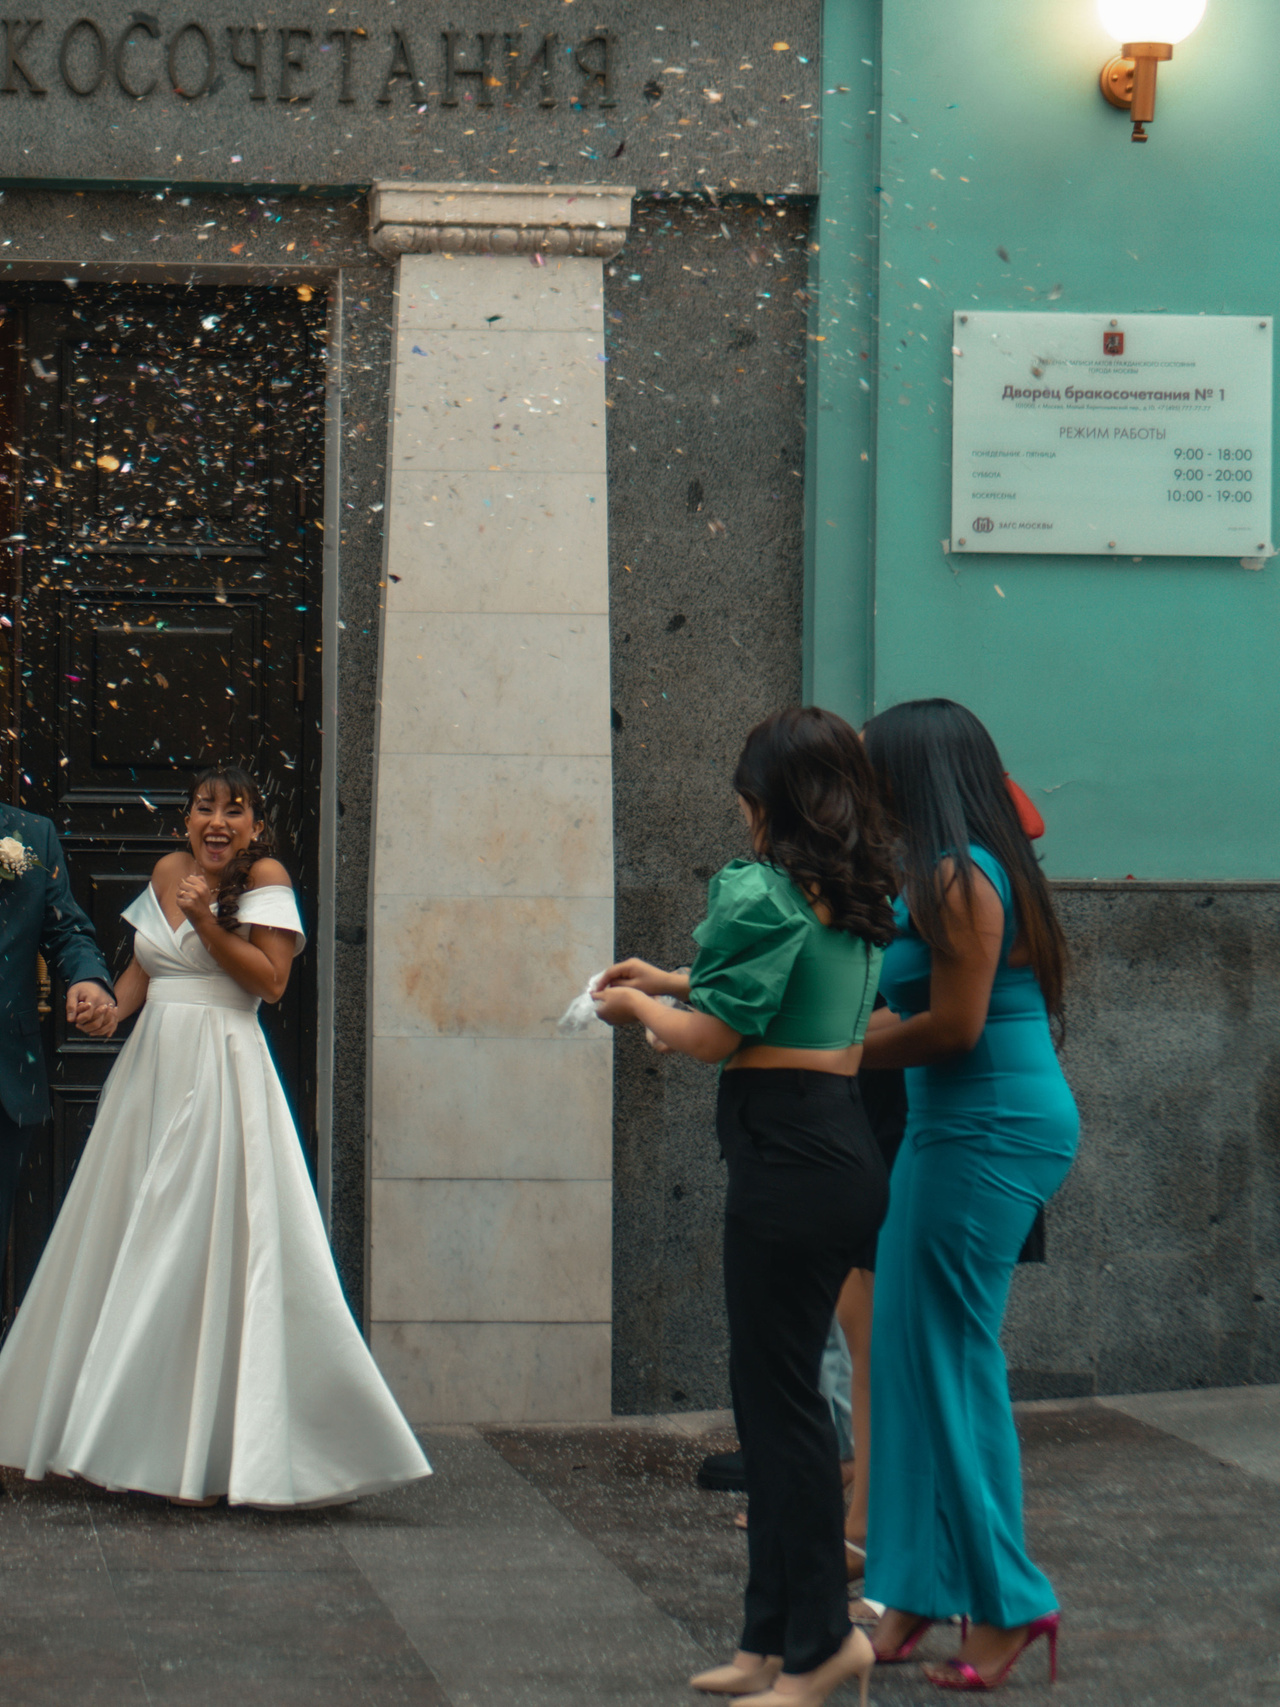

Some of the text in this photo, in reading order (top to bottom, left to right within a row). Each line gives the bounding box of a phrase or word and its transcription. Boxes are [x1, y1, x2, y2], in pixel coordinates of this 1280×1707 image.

[1002, 385, 1226, 402] Дворец бракосочетания № 1
[1059, 426, 1166, 440] РЕЖИМ РАБОТЫ
[1174, 448, 1203, 461] 9:00
[1218, 448, 1252, 461] 18:00
[1174, 469, 1203, 482] 9:00
[1215, 469, 1252, 482] 20:00
[1167, 490, 1203, 502] 10:00
[1217, 490, 1252, 503] 19:00
[998, 522, 1054, 530] ЗАГС МОСКВЫ
